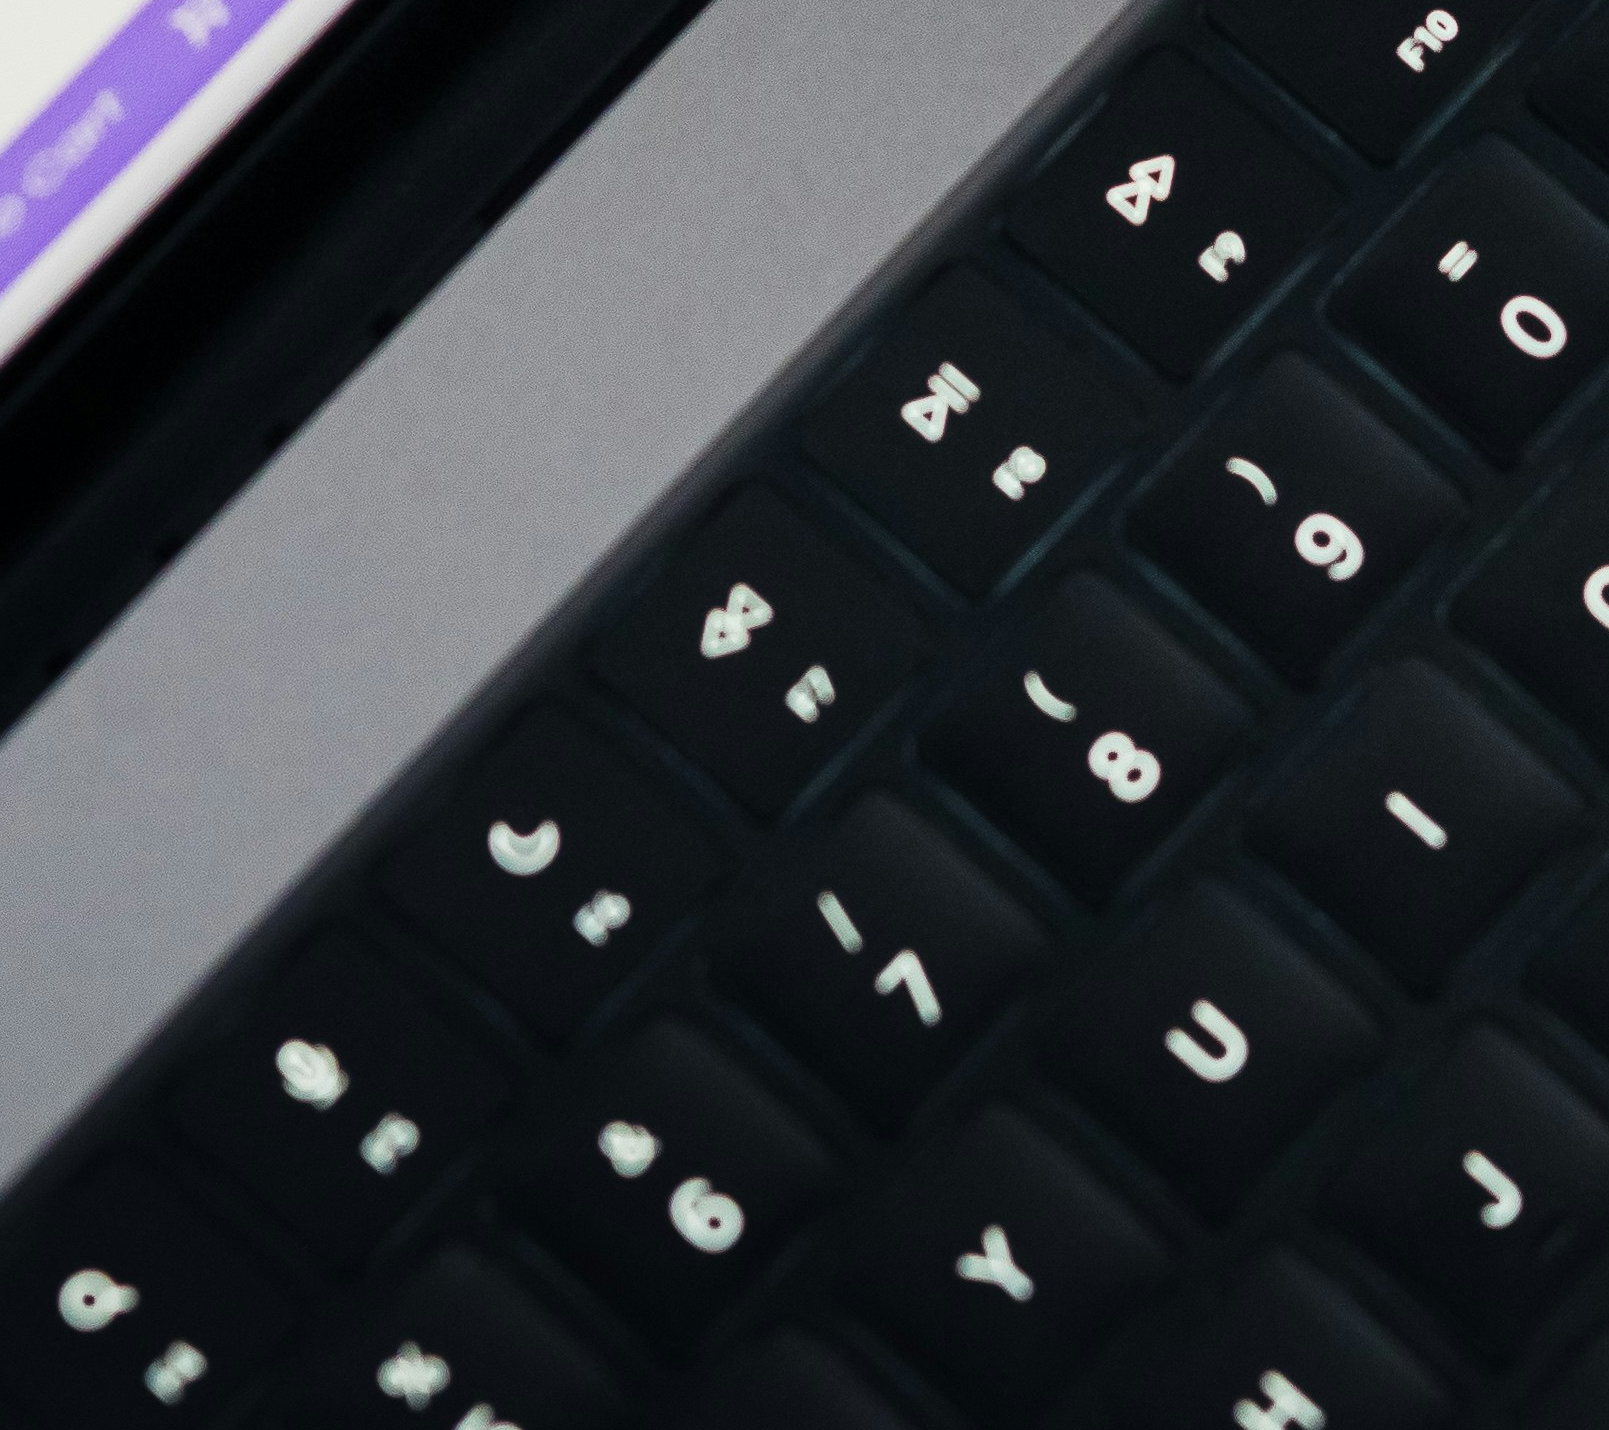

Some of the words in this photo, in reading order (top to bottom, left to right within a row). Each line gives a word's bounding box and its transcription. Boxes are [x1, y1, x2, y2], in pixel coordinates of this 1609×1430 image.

[1393, 7, 1461, 75] F10
[1292, 510, 1367, 583] 9
[1085, 728, 1163, 805] 8
[873, 947, 943, 1025] 7
[1164, 997, 1251, 1084] U
[668, 1175, 746, 1254] 6
[1461, 1149, 1524, 1230] J
[957, 1225, 1035, 1302] Y
[1233, 1369, 1326, 1430] H
